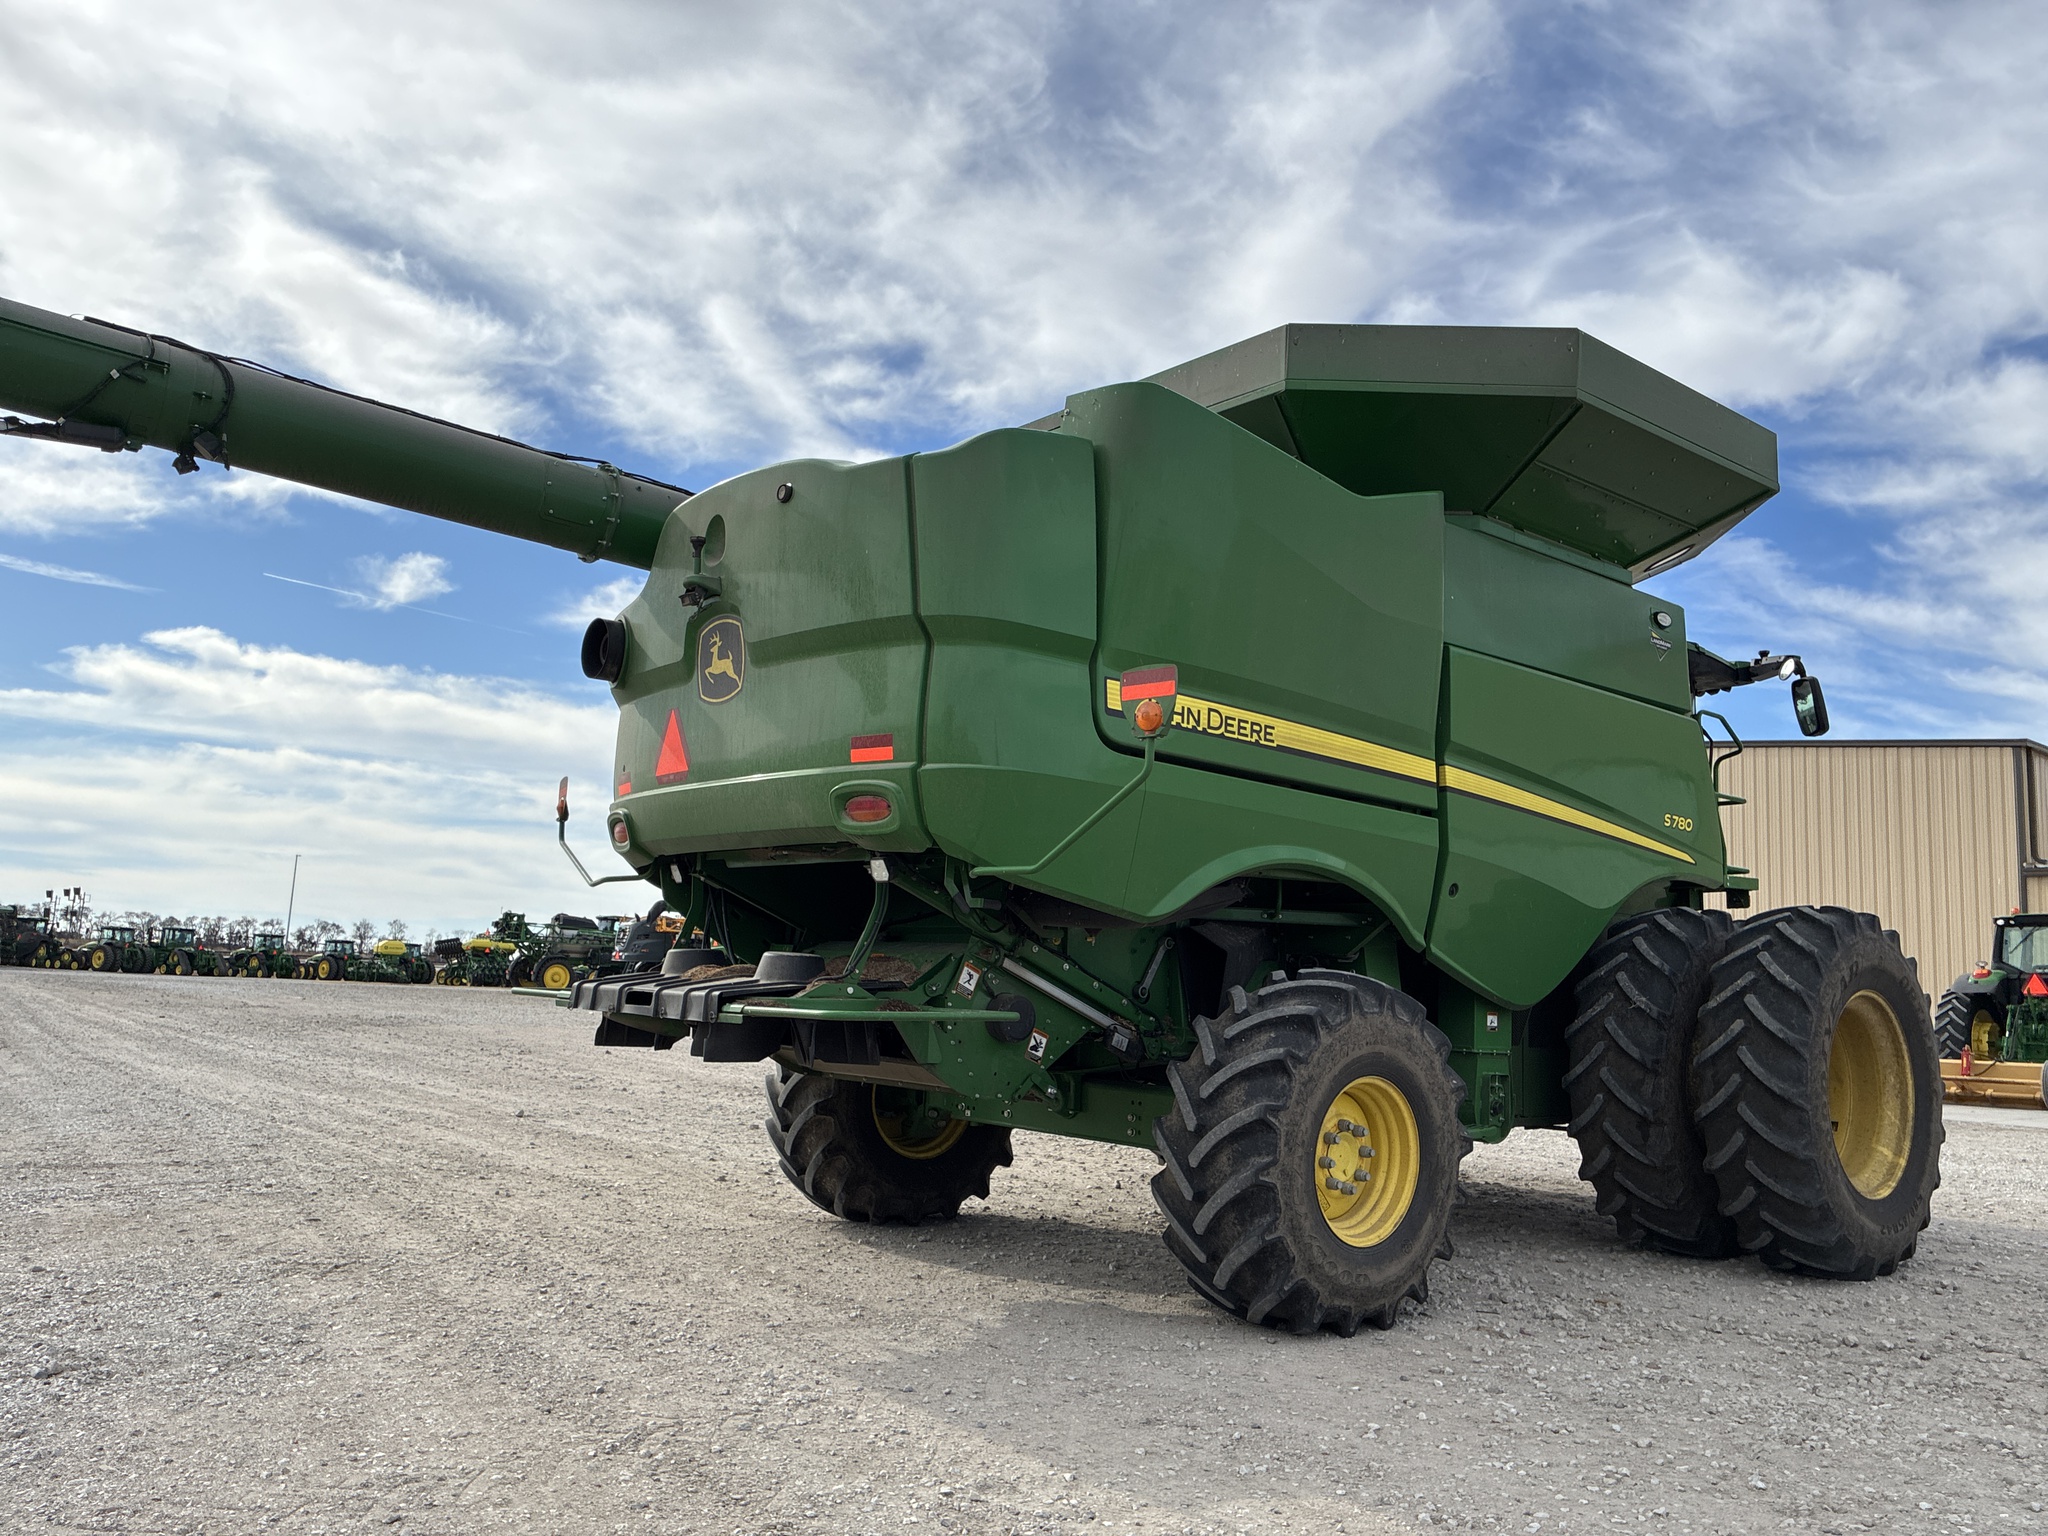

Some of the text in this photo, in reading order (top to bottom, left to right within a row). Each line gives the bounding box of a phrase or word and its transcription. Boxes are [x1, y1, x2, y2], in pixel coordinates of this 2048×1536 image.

[1172, 705, 1276, 744] HN DEERE
[1663, 812, 1694, 832] S780
